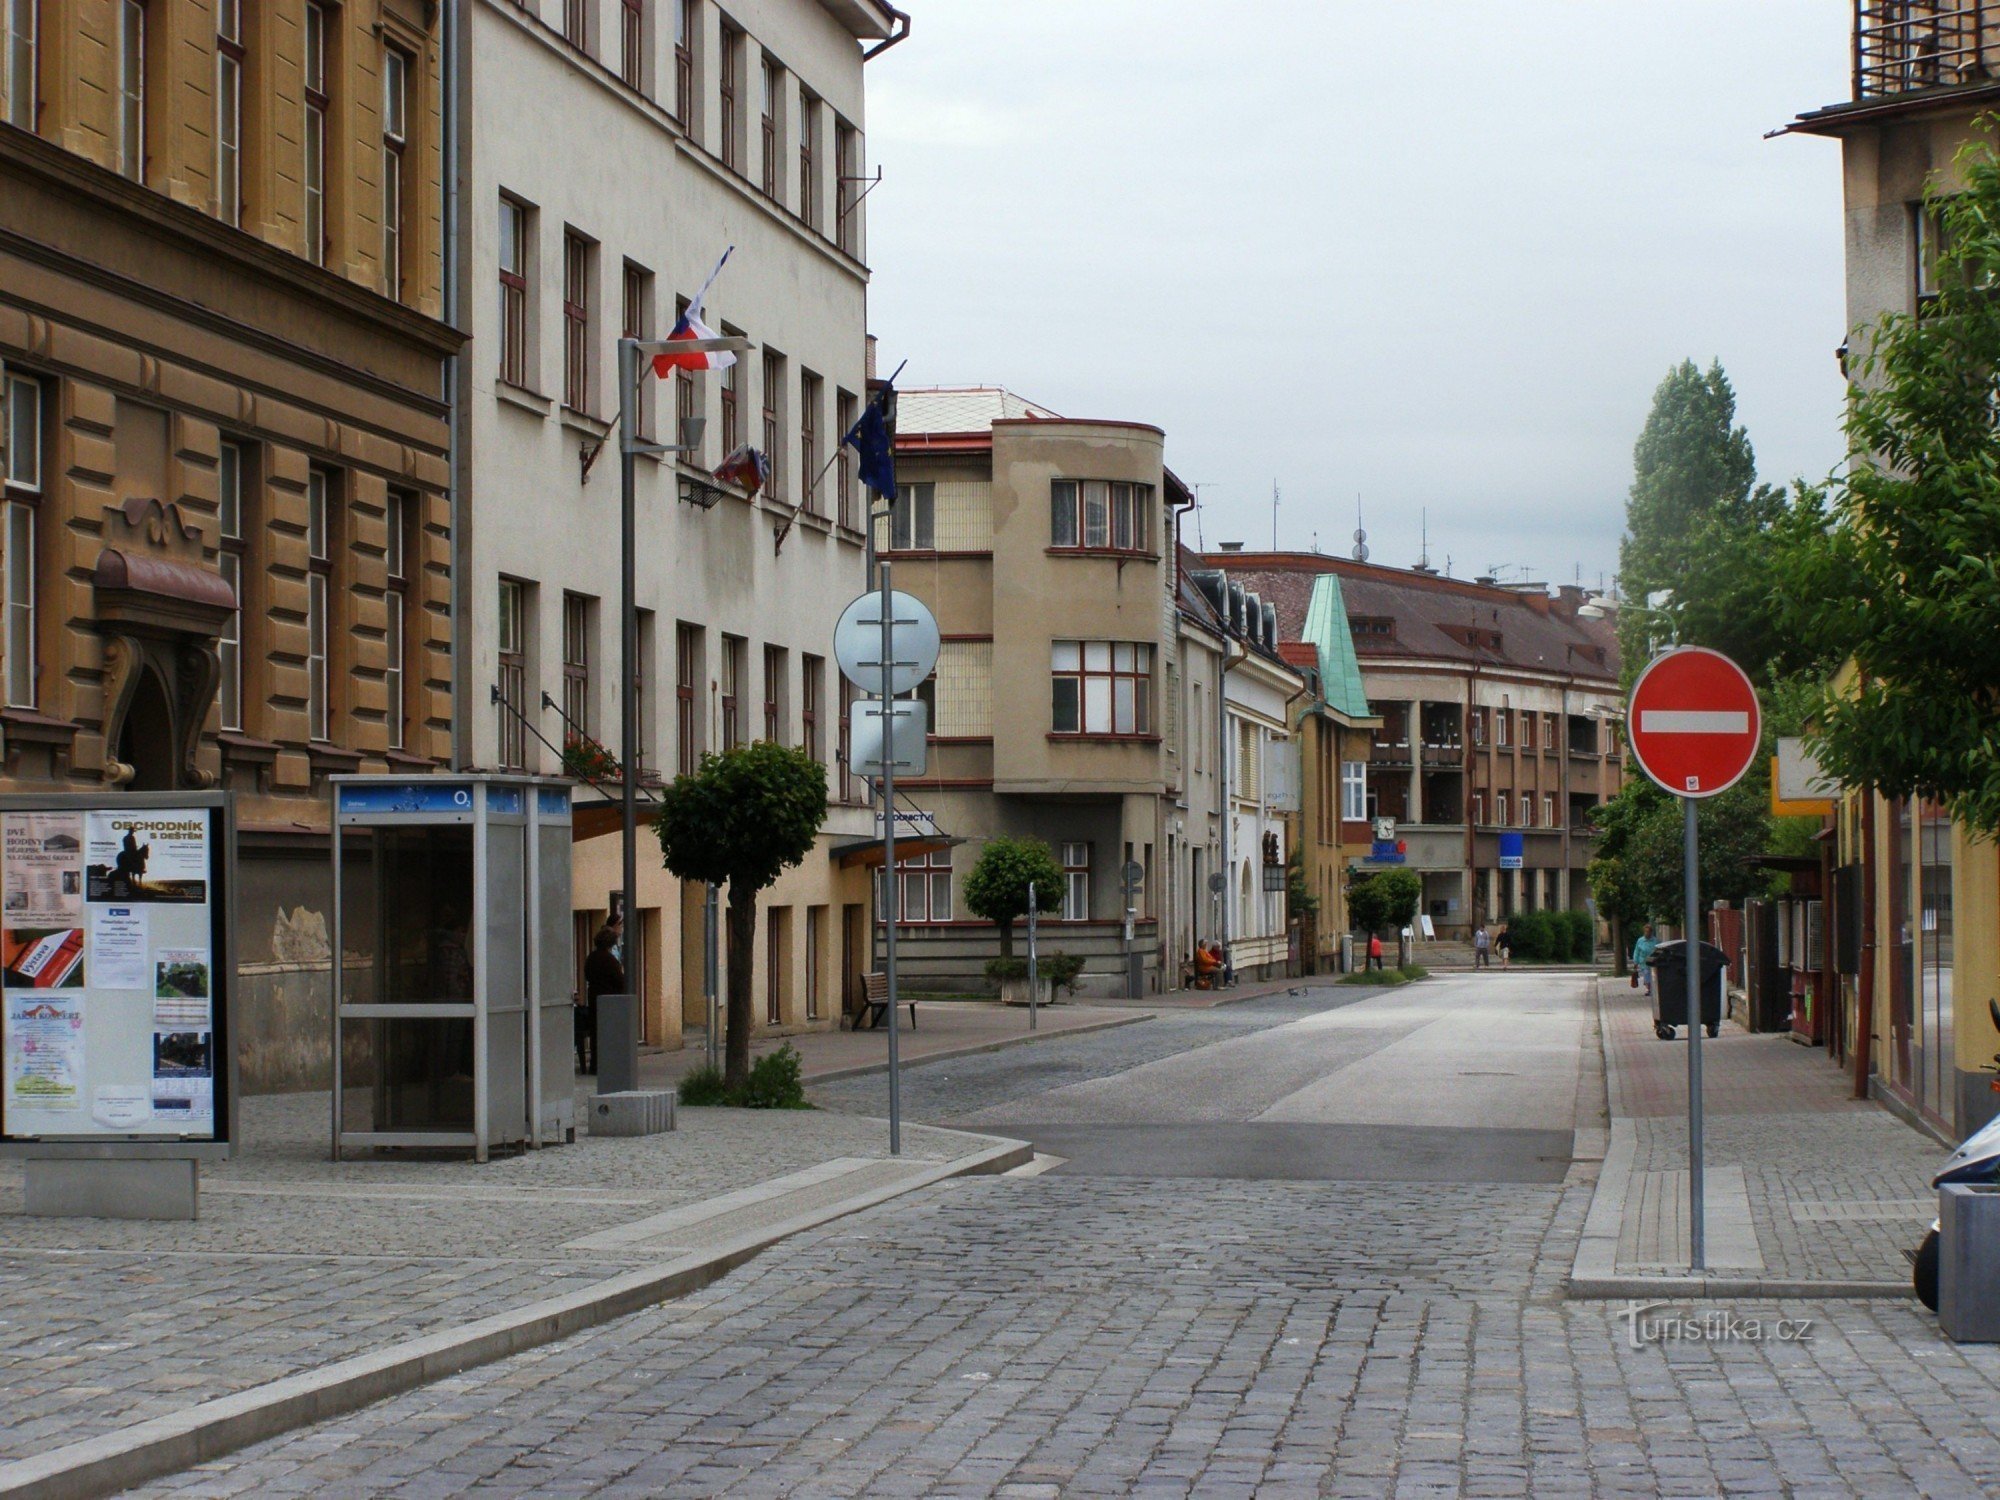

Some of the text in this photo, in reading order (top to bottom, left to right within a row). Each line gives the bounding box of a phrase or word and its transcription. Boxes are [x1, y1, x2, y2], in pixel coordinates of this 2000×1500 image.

[111, 820, 203, 831] OBCHODNÍK
[160, 832, 203, 840] DEŠTĚM
[22, 944, 50, 973] Výstava
